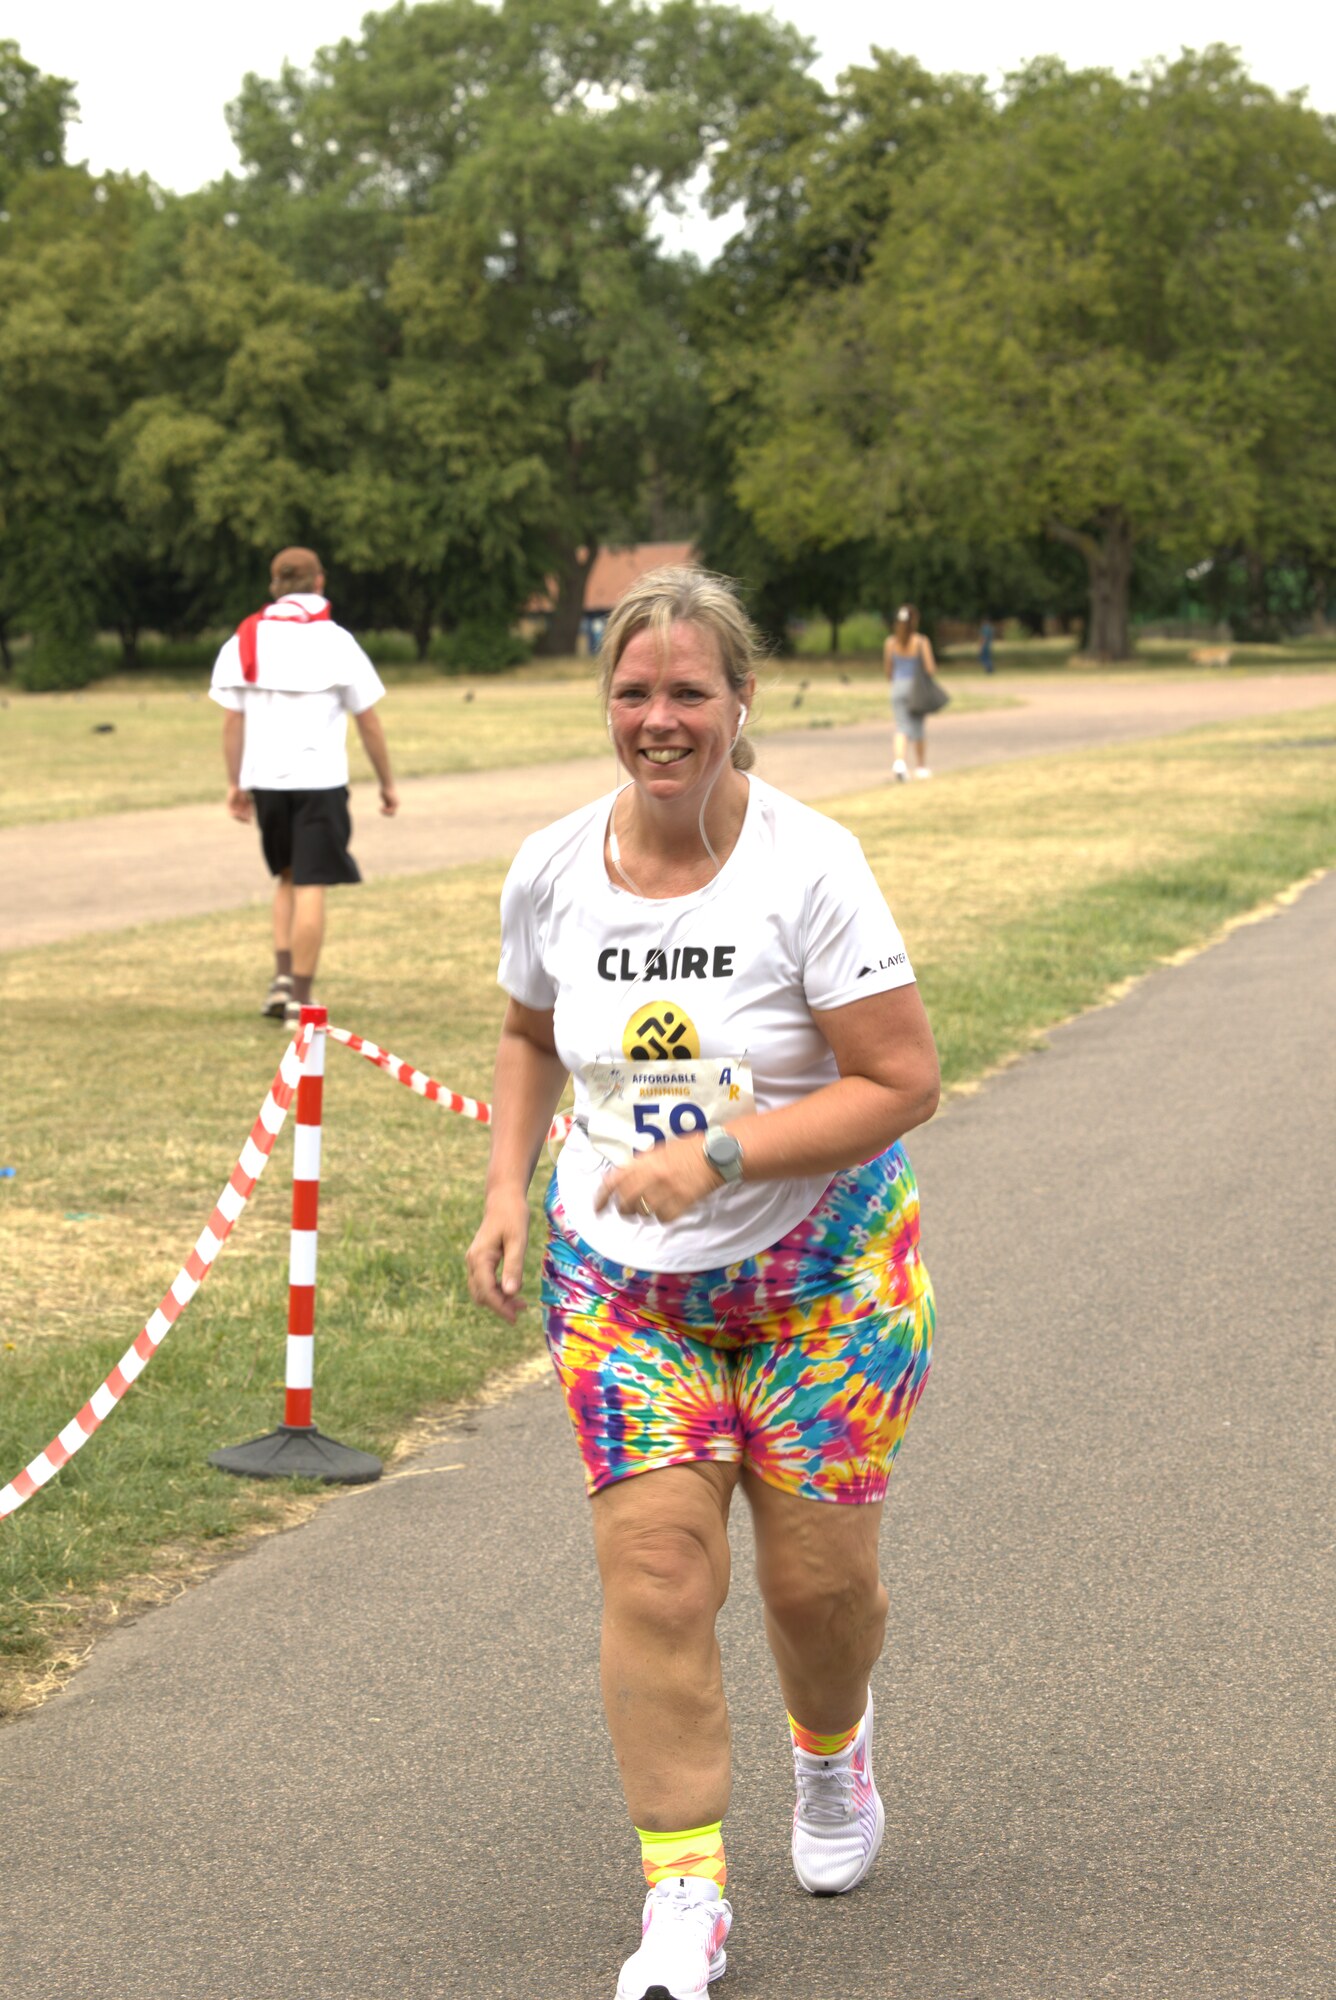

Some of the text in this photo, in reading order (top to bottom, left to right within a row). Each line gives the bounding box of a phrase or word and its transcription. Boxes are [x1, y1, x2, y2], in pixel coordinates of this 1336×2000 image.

[598, 945, 736, 982] CLAIRE
[633, 1073, 696, 1085] AFFORDABLE
[640, 1086, 691, 1097] RUNNING
[633, 1102, 708, 1158] 59
